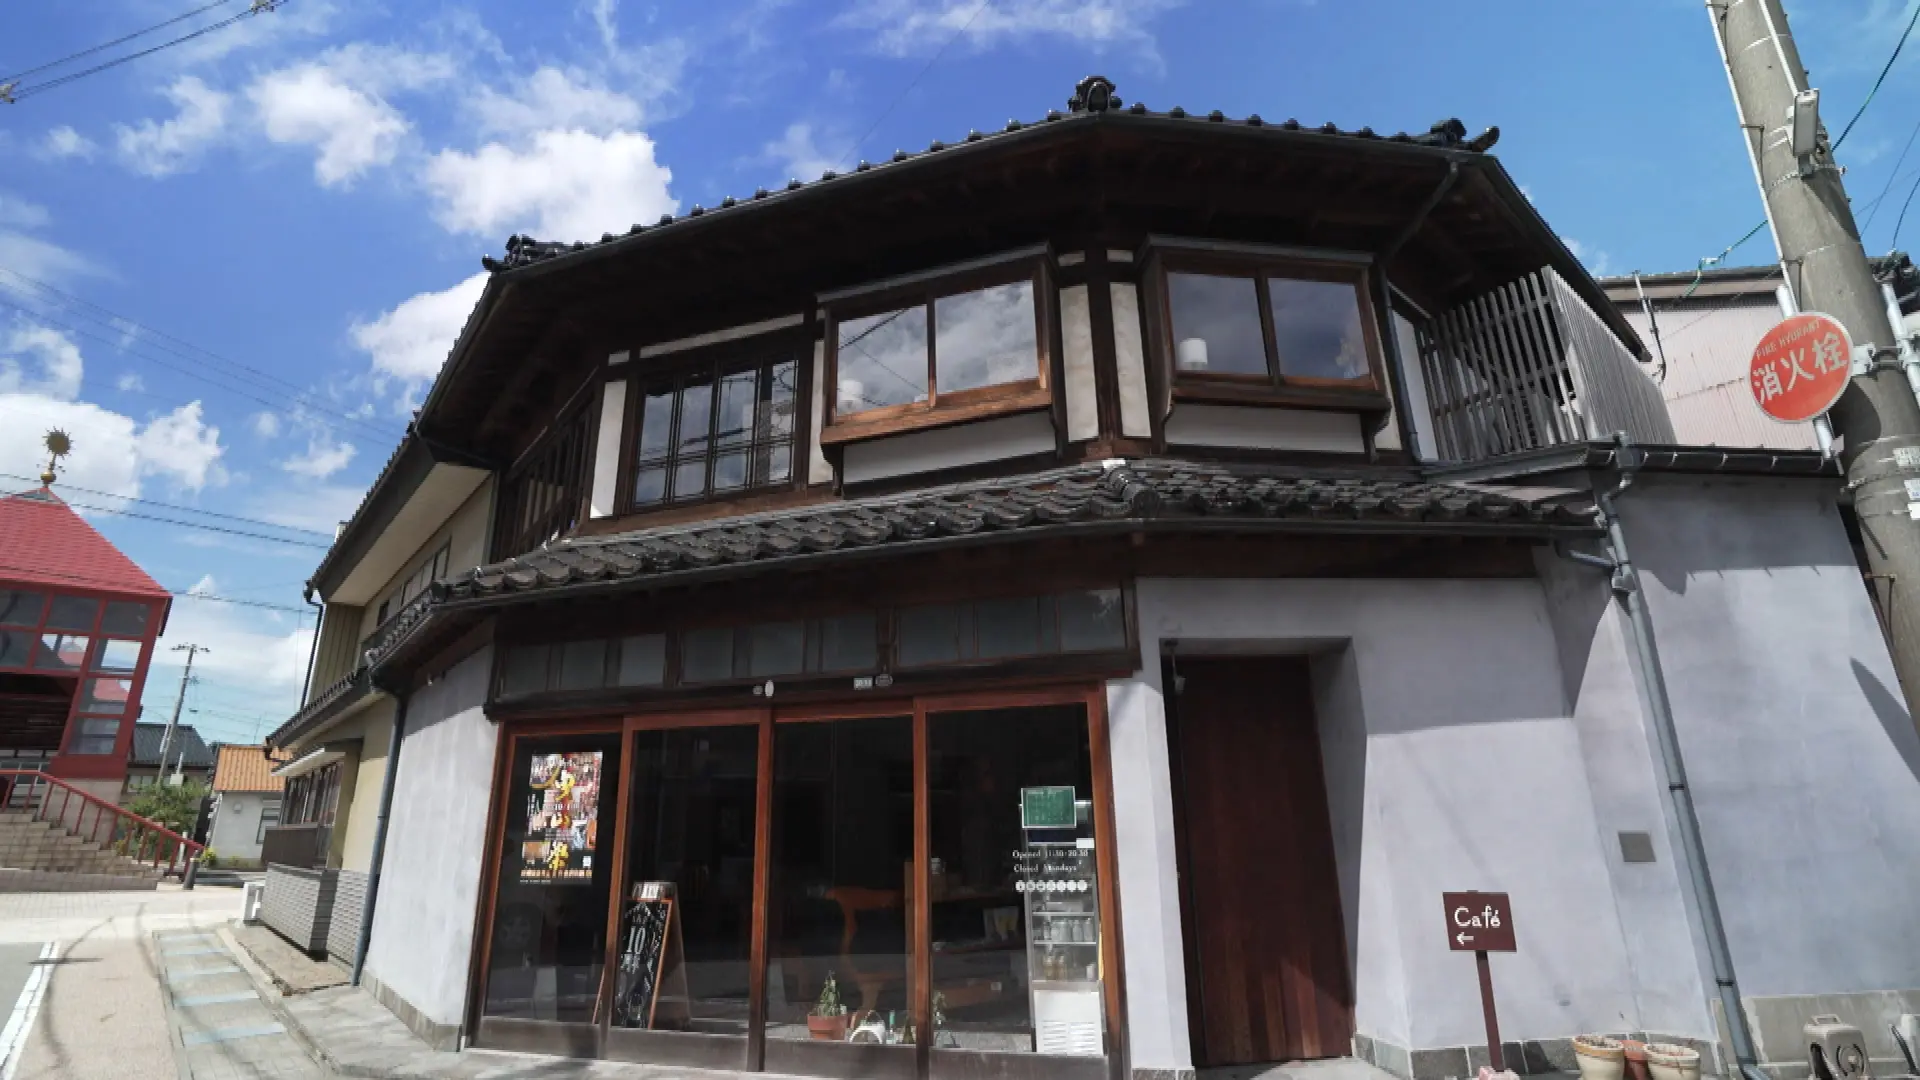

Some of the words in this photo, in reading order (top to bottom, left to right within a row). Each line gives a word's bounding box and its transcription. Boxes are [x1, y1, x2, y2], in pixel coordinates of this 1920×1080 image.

[1756, 342, 1777, 360] FIRE
[1779, 320, 1820, 348] HYDRANT
[1752, 332, 1848, 405] 消火栓
[1012, 850, 1041, 860] Opened
[1013, 864, 1039, 873] Closed
[1454, 904, 1501, 928] Café
